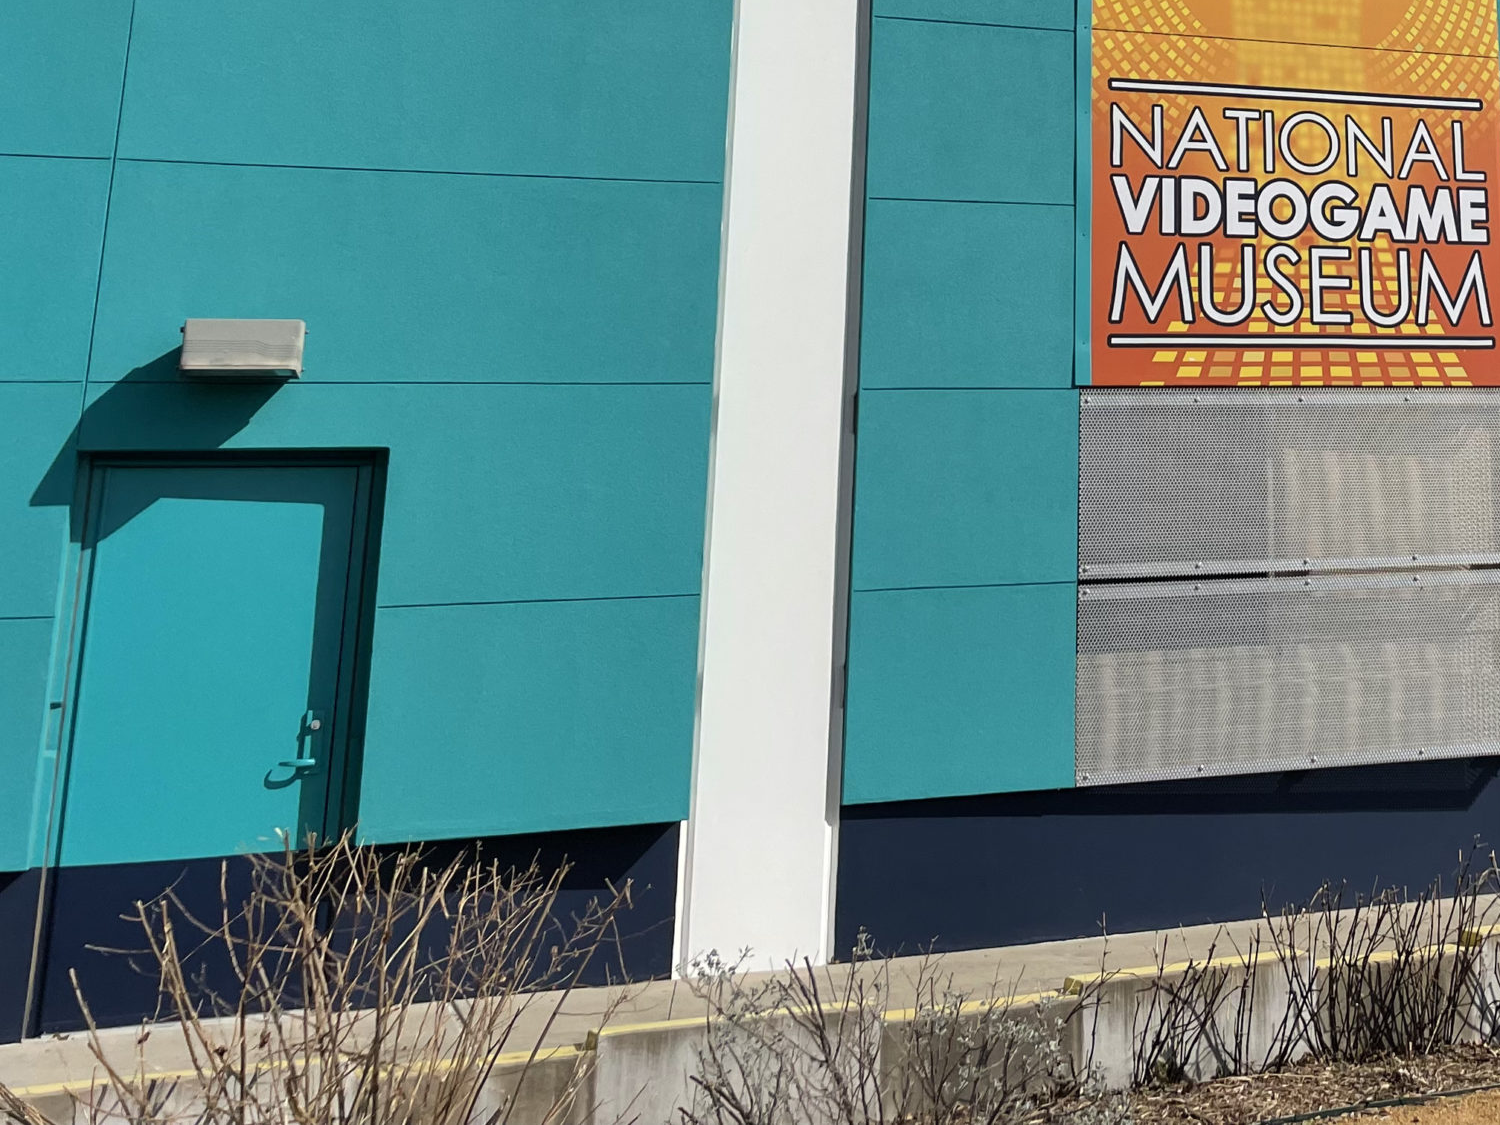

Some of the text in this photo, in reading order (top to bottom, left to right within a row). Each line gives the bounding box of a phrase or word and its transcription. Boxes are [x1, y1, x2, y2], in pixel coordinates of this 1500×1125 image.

[1110, 101, 1486, 182] NATIONAL
[1110, 175, 1490, 243] VIDEOGAME
[1109, 240, 1493, 327] MUSEUM
